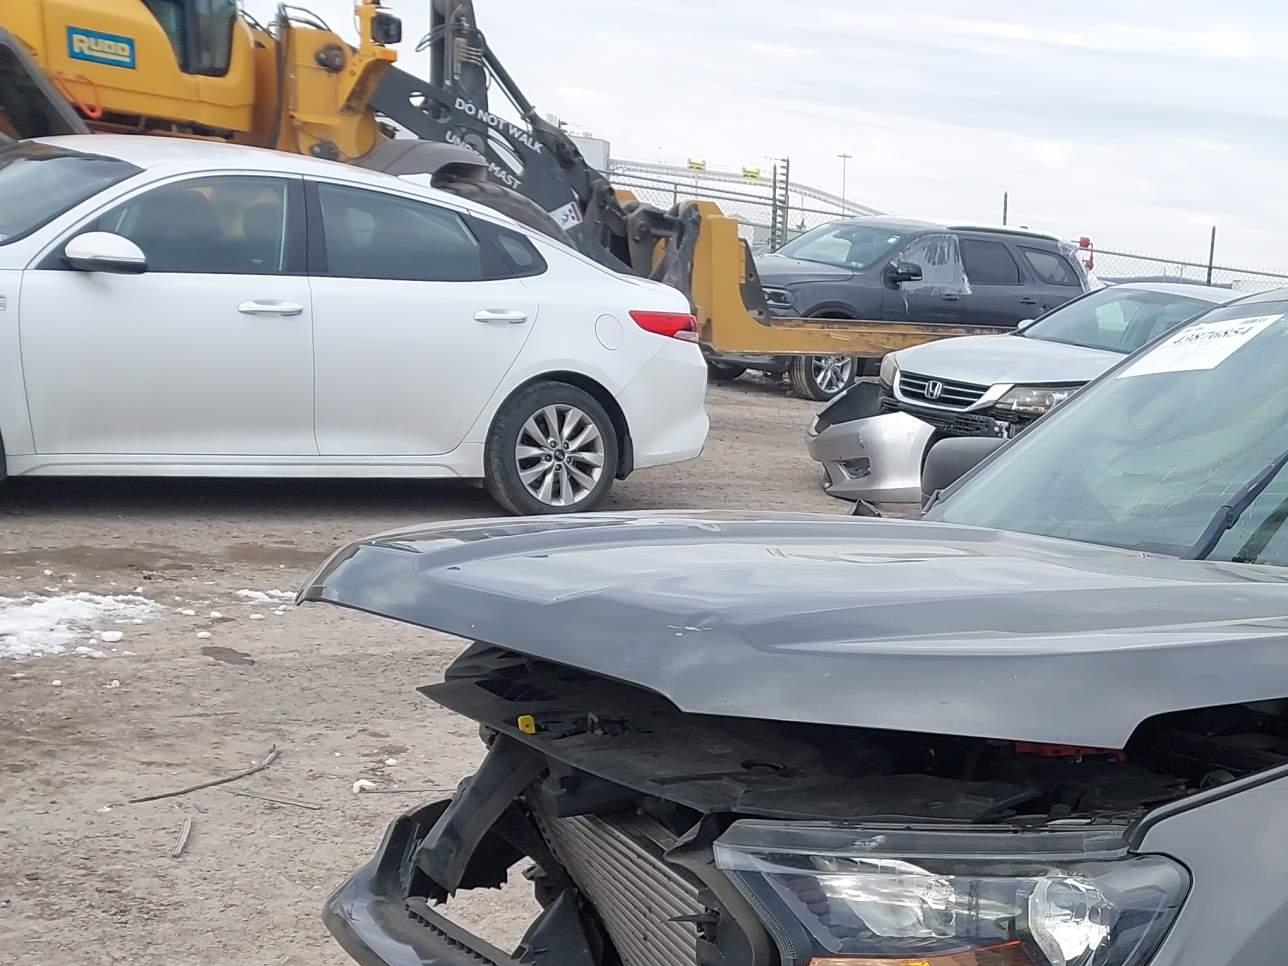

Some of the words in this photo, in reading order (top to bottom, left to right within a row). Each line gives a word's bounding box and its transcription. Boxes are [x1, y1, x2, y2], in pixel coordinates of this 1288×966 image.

[72, 33, 131, 62] RUDD
[454, 98, 476, 115] DO
[477, 109, 506, 130] NOT
[508, 122, 544, 154] WALK
[488, 162, 522, 190] MAST
